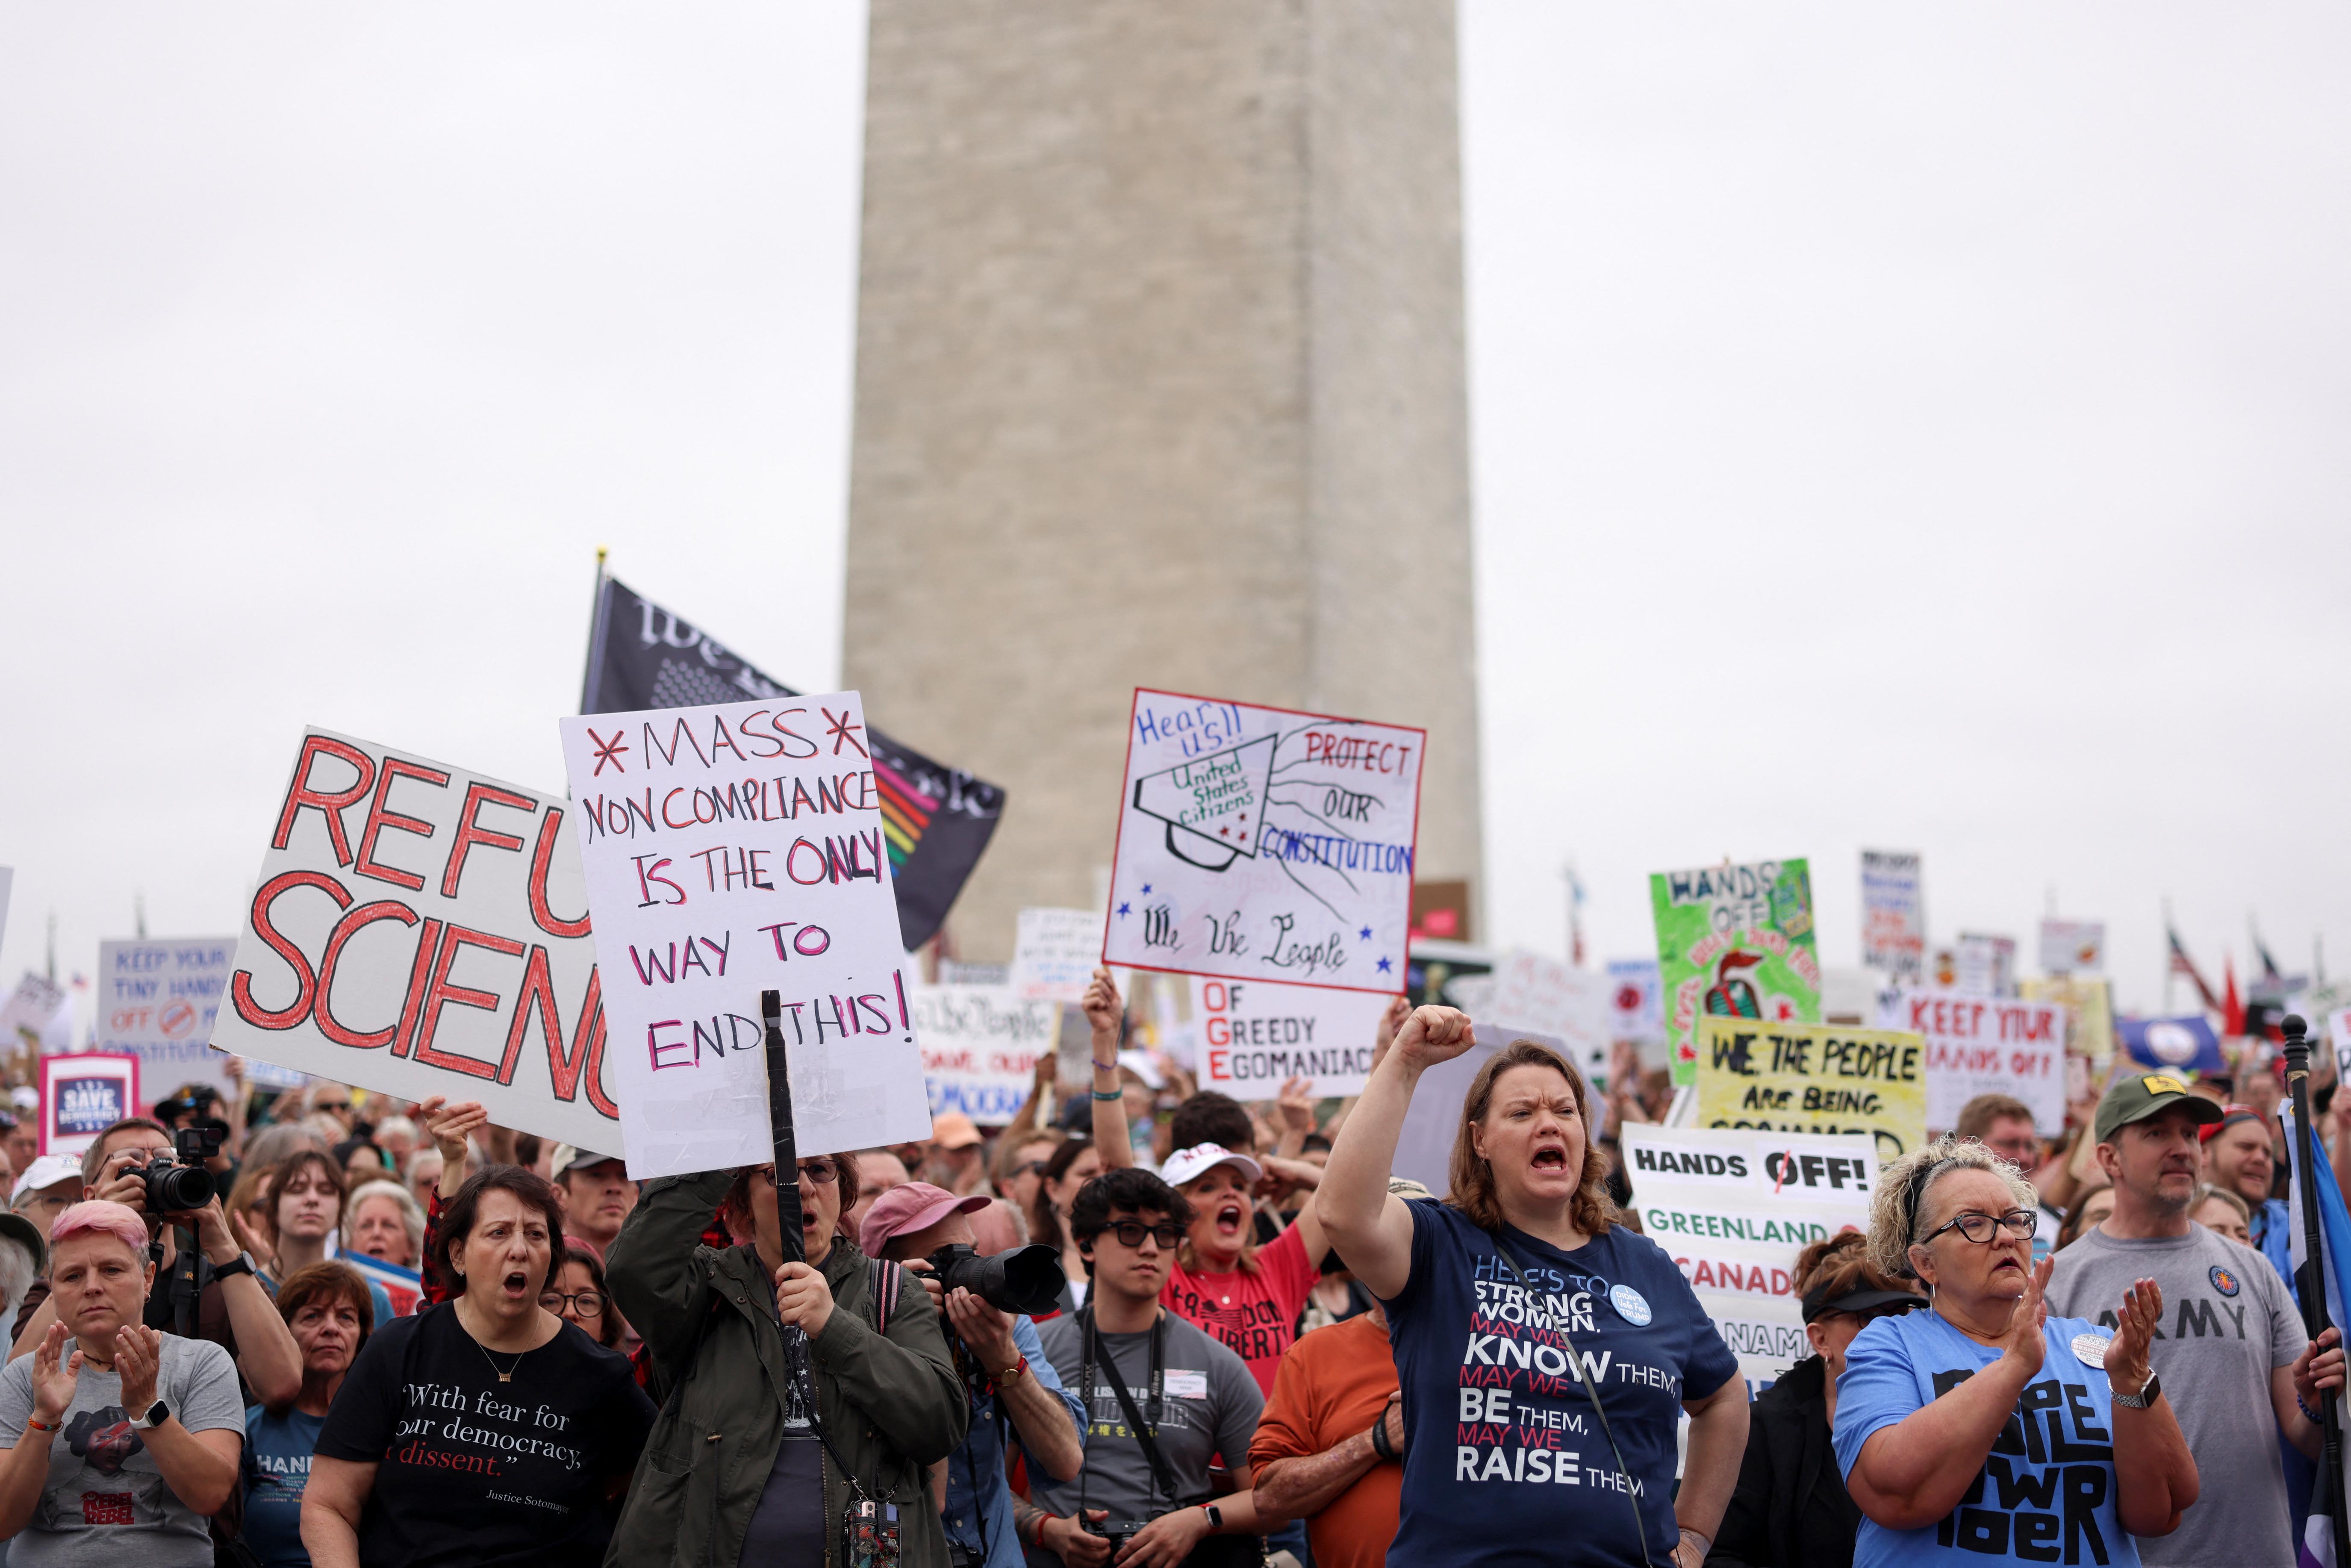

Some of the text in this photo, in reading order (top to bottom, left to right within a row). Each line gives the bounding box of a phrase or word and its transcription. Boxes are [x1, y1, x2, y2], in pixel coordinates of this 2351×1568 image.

[644, 707, 819, 769] MASS
[1137, 702, 1212, 745] Hear
[1172, 750, 1241, 789] United
[1305, 731, 1411, 776] PROTECT
[1324, 789, 1370, 823] OUR
[631, 827, 883, 908] IS THE ONLY
[1261, 827, 1414, 876] CONSTITUTION
[1670, 862, 1776, 903] HANDS
[1712, 902, 1769, 934] OFF
[115, 947, 168, 972] KEEP
[628, 921, 831, 986] WAY TO
[1260, 912, 1349, 979] People
[1203, 982, 1243, 1012] OF
[111, 1005, 154, 1033] OFF
[648, 1013, 762, 1071] END
[781, 969, 912, 1045] THIS!
[1207, 1017, 1316, 1046] GREEDY
[1910, 998, 1984, 1037] KEEP
[1208, 1047, 1376, 1082] EGOMANIAC
[1767, 1035, 1812, 1075] THE
[1822, 1037, 1919, 1081] PEOPLE
[65, 1088, 115, 1110] SAVE
[1743, 1085, 1883, 1114] ARE BEING
[1635, 1148, 1868, 1192] HANDS OFF!
[1647, 1209, 1828, 1245] GREENLAND
[1569, 1274, 1609, 1297] TO
[1672, 1258, 1792, 1296] CANAD
[1475, 1281, 1592, 1316] STRONG
[1615, 1291, 1642, 1303] DIDN'T
[1617, 1298, 1633, 1310] Vote
[1620, 1308, 1650, 1321] TRUMP
[1470, 1312, 1568, 1350] MAY WE
[1479, 1302, 1600, 1332] WOMEN.
[2073, 1344, 2104, 1356] RESISTA
[2080, 1336, 2110, 1347] INJUSTIC
[1458, 1365, 1568, 1397] MAY WE
[1464, 1332, 1676, 1398] KNOW THEM,
[474, 1391, 527, 1422] fear
[533, 1405, 570, 1431] for
[1459, 1388, 1588, 1435] BE THEM,
[395, 1417, 581, 1470] our democracy,
[1457, 1424, 1561, 1450] MAY WE
[1456, 1446, 1580, 1485] RAISE
[80, 1491, 134, 1512] REBEL
[85, 1505, 135, 1524] REBEL
[486, 1490, 570, 1514] Justice Sotomayor
